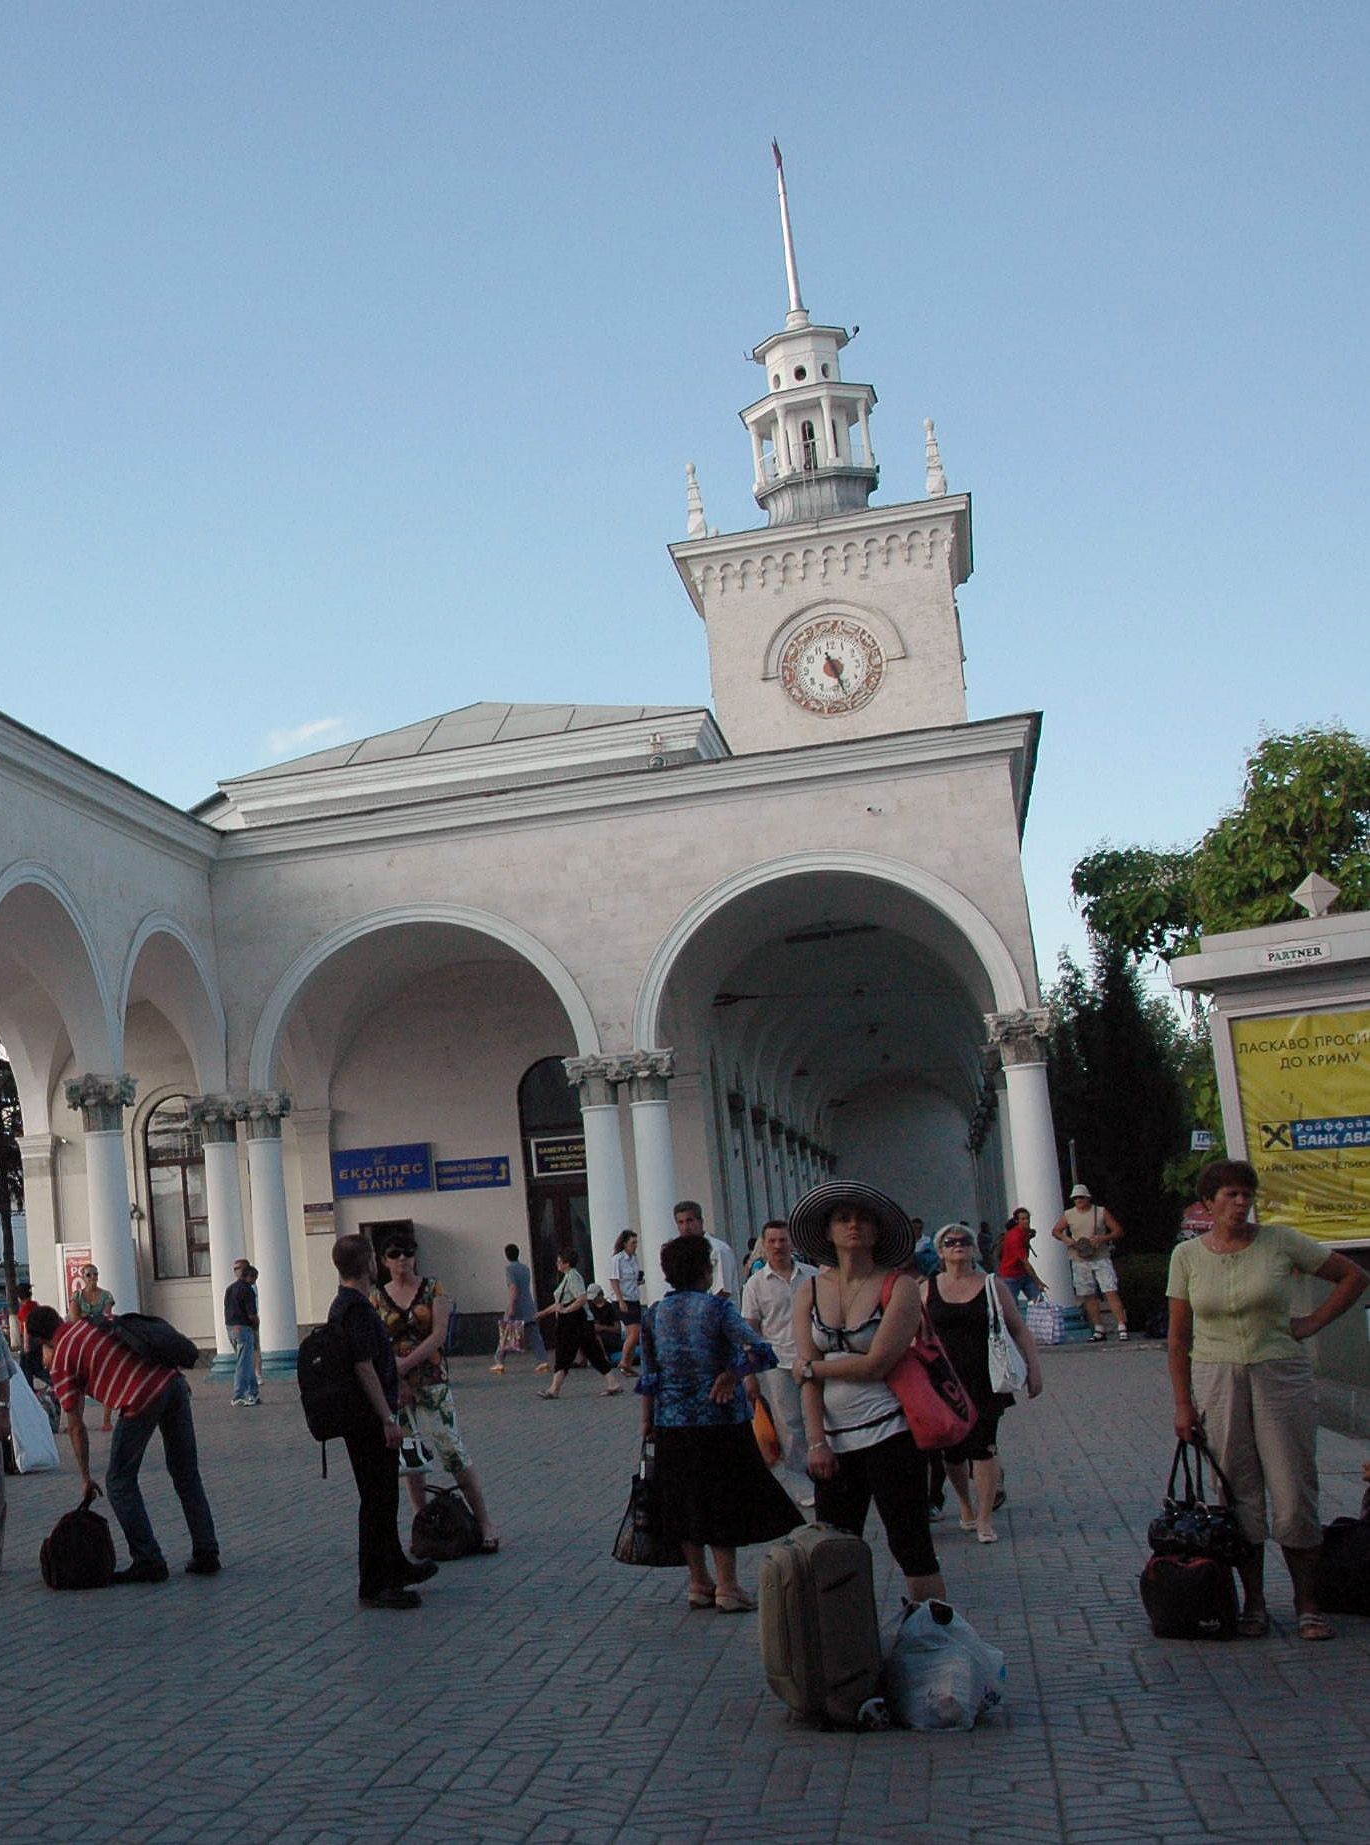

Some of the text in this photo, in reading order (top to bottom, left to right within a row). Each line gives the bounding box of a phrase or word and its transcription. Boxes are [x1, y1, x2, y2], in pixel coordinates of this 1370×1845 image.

[1268, 947, 1322, 962] PARTNER
[1238, 1033, 1370, 1054] ЛАСКАВО ПРОСИ
[1280, 1052, 1361, 1071] ДО КРИМУ
[1297, 1133, 1339, 1146] БАНК
[339, 1162, 423, 1181] ЕКСПРЕС
[357, 1177, 406, 1191] БАНК
